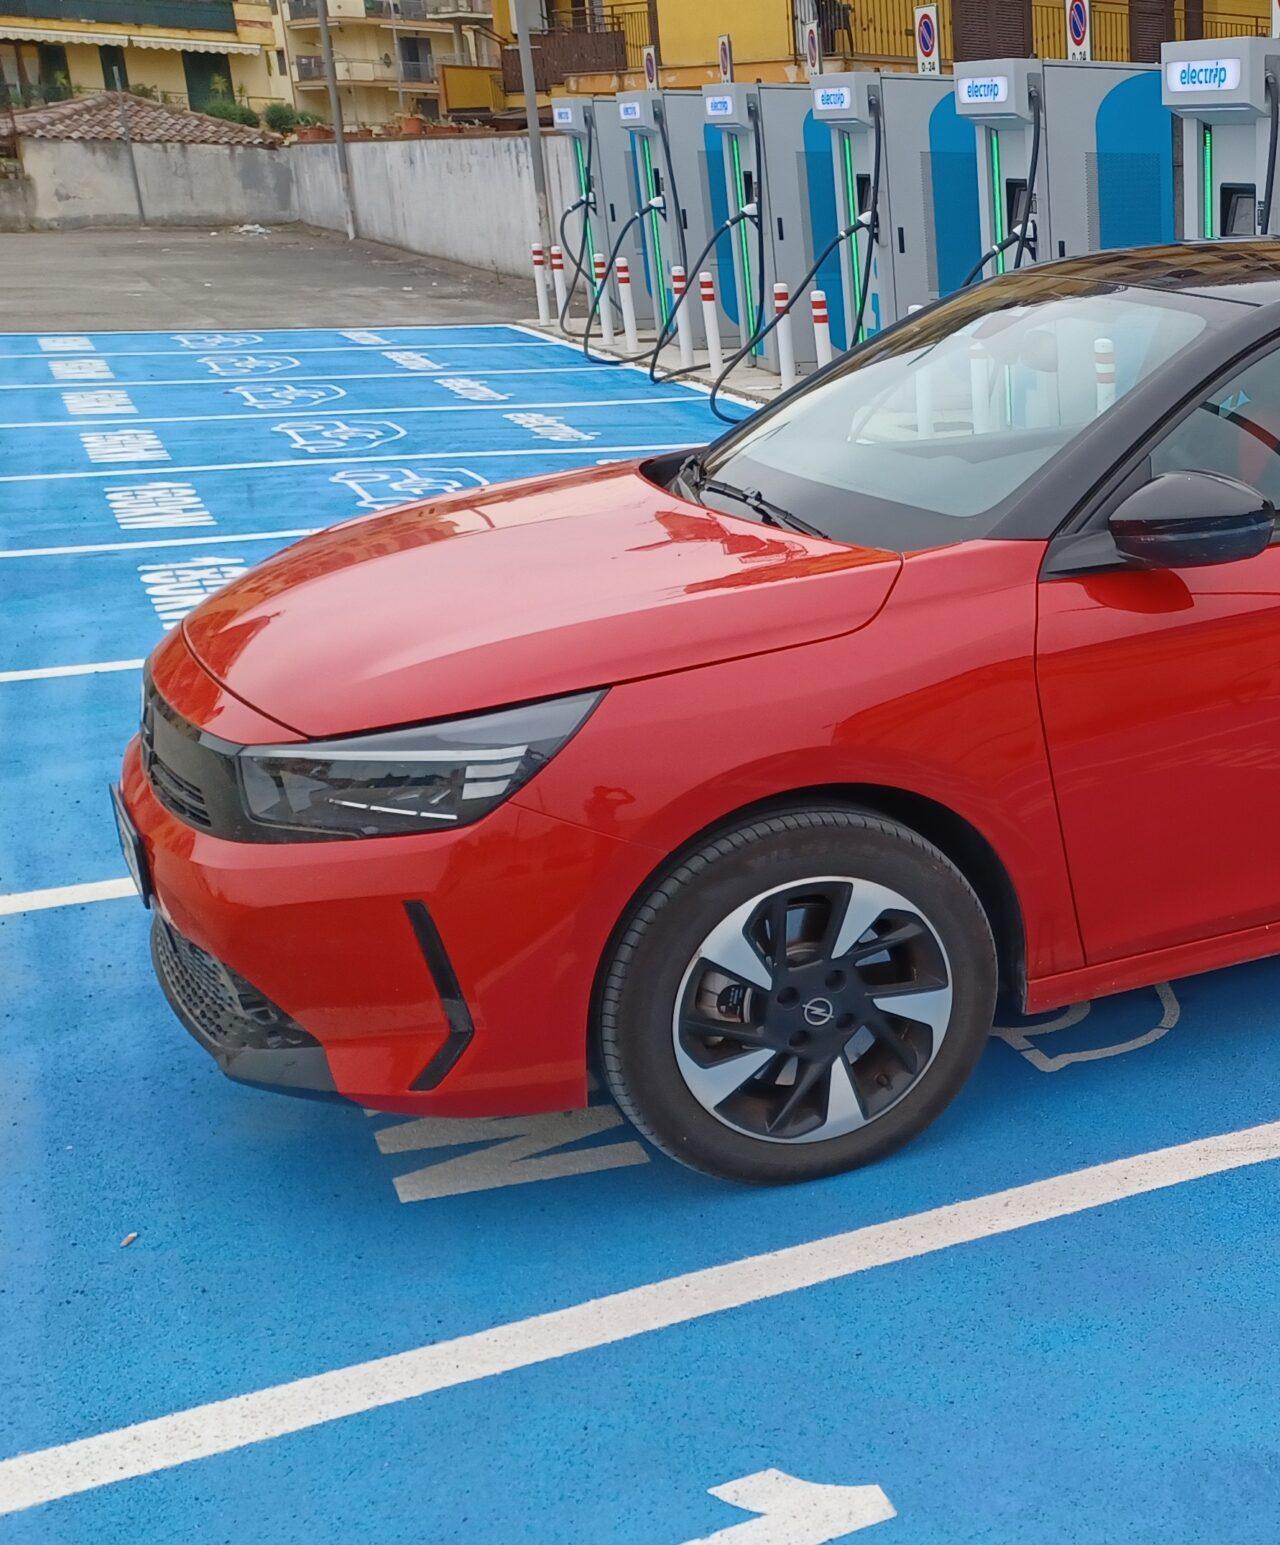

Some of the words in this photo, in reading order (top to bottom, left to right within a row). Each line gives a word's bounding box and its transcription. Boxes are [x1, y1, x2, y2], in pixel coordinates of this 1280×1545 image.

[1180, 63, 1227, 87] electrip
[967, 79, 998, 100] electrip
[137, 556, 250, 630] 180
